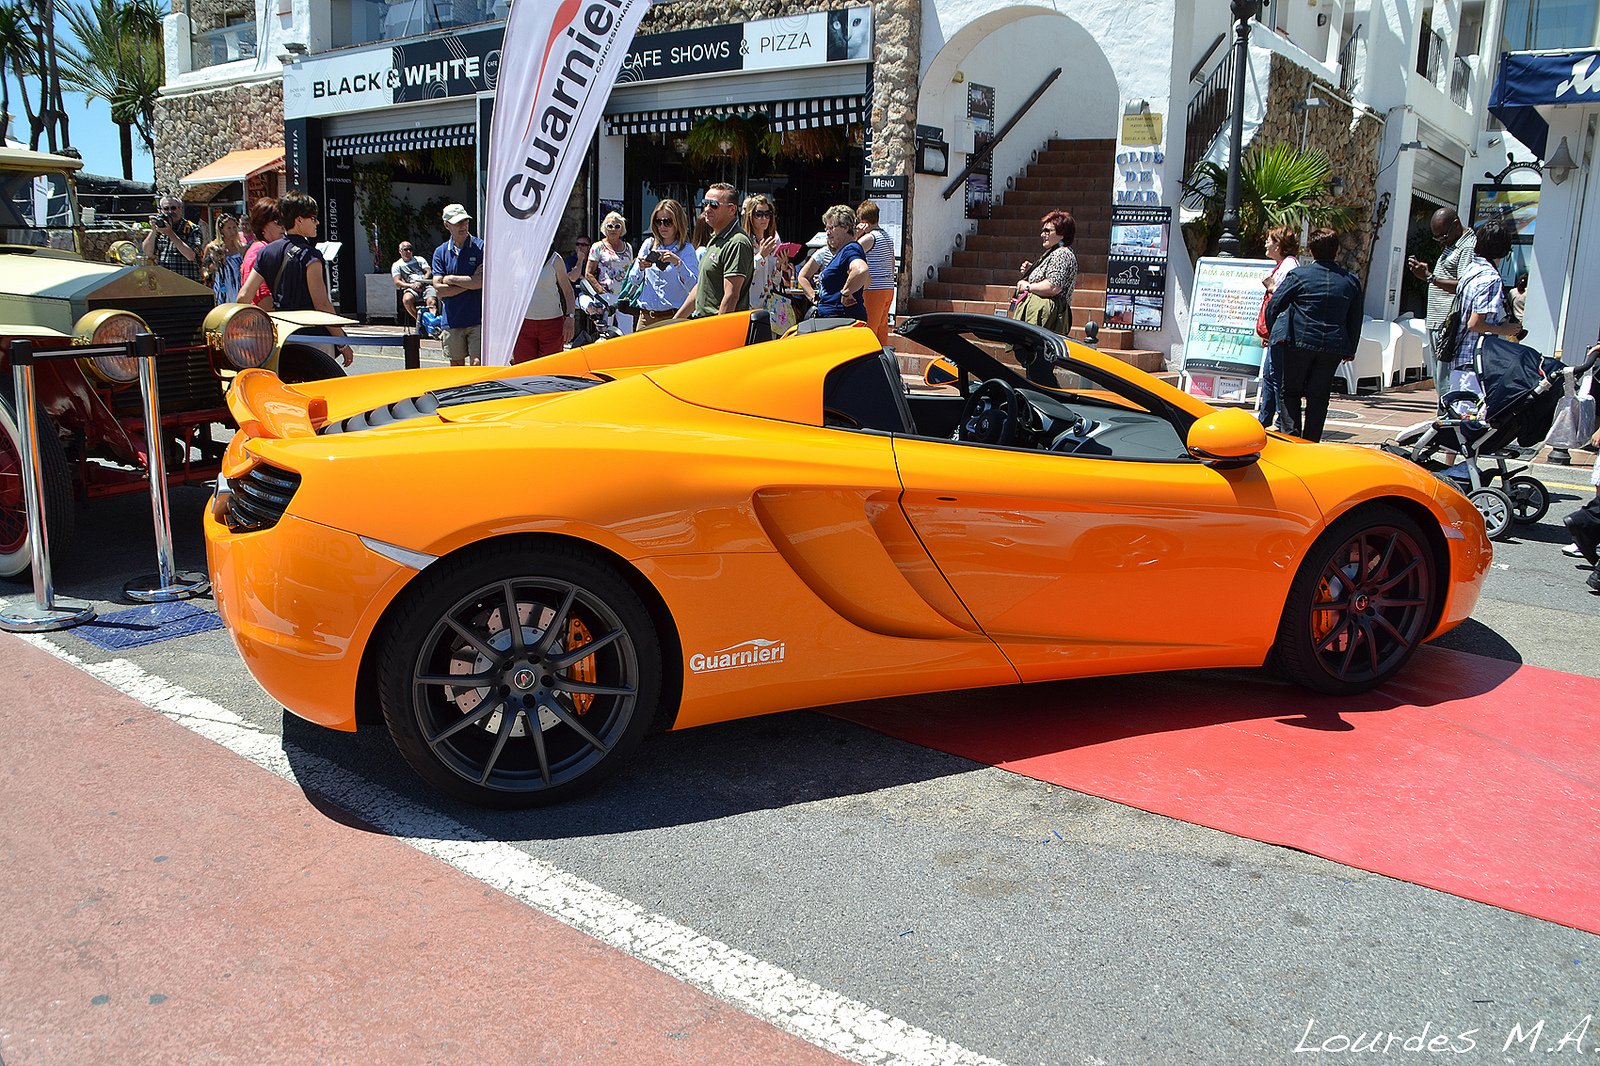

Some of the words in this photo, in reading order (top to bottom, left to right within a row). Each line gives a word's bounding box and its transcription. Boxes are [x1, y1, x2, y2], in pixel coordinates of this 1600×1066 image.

[622, 49, 662, 70] CAFE
[670, 40, 730, 64] SHOWS
[738, 39, 750, 56] &
[760, 32, 812, 53] PIZZA
[313, 71, 381, 98] BLACK
[386, 68, 402, 89] &
[404, 56, 480, 87] WHITE
[503, 0, 622, 220] Guarnie
[292, 129, 300, 186] PIZZERIA
[864, 127, 873, 175] TAILS
[1116, 150, 1165, 166] CLUB
[1125, 170, 1152, 183] DE
[1116, 190, 1159, 203] MAR
[1235, 271, 1267, 279] MARBEL
[689, 642, 785, 671] Guarnieri
